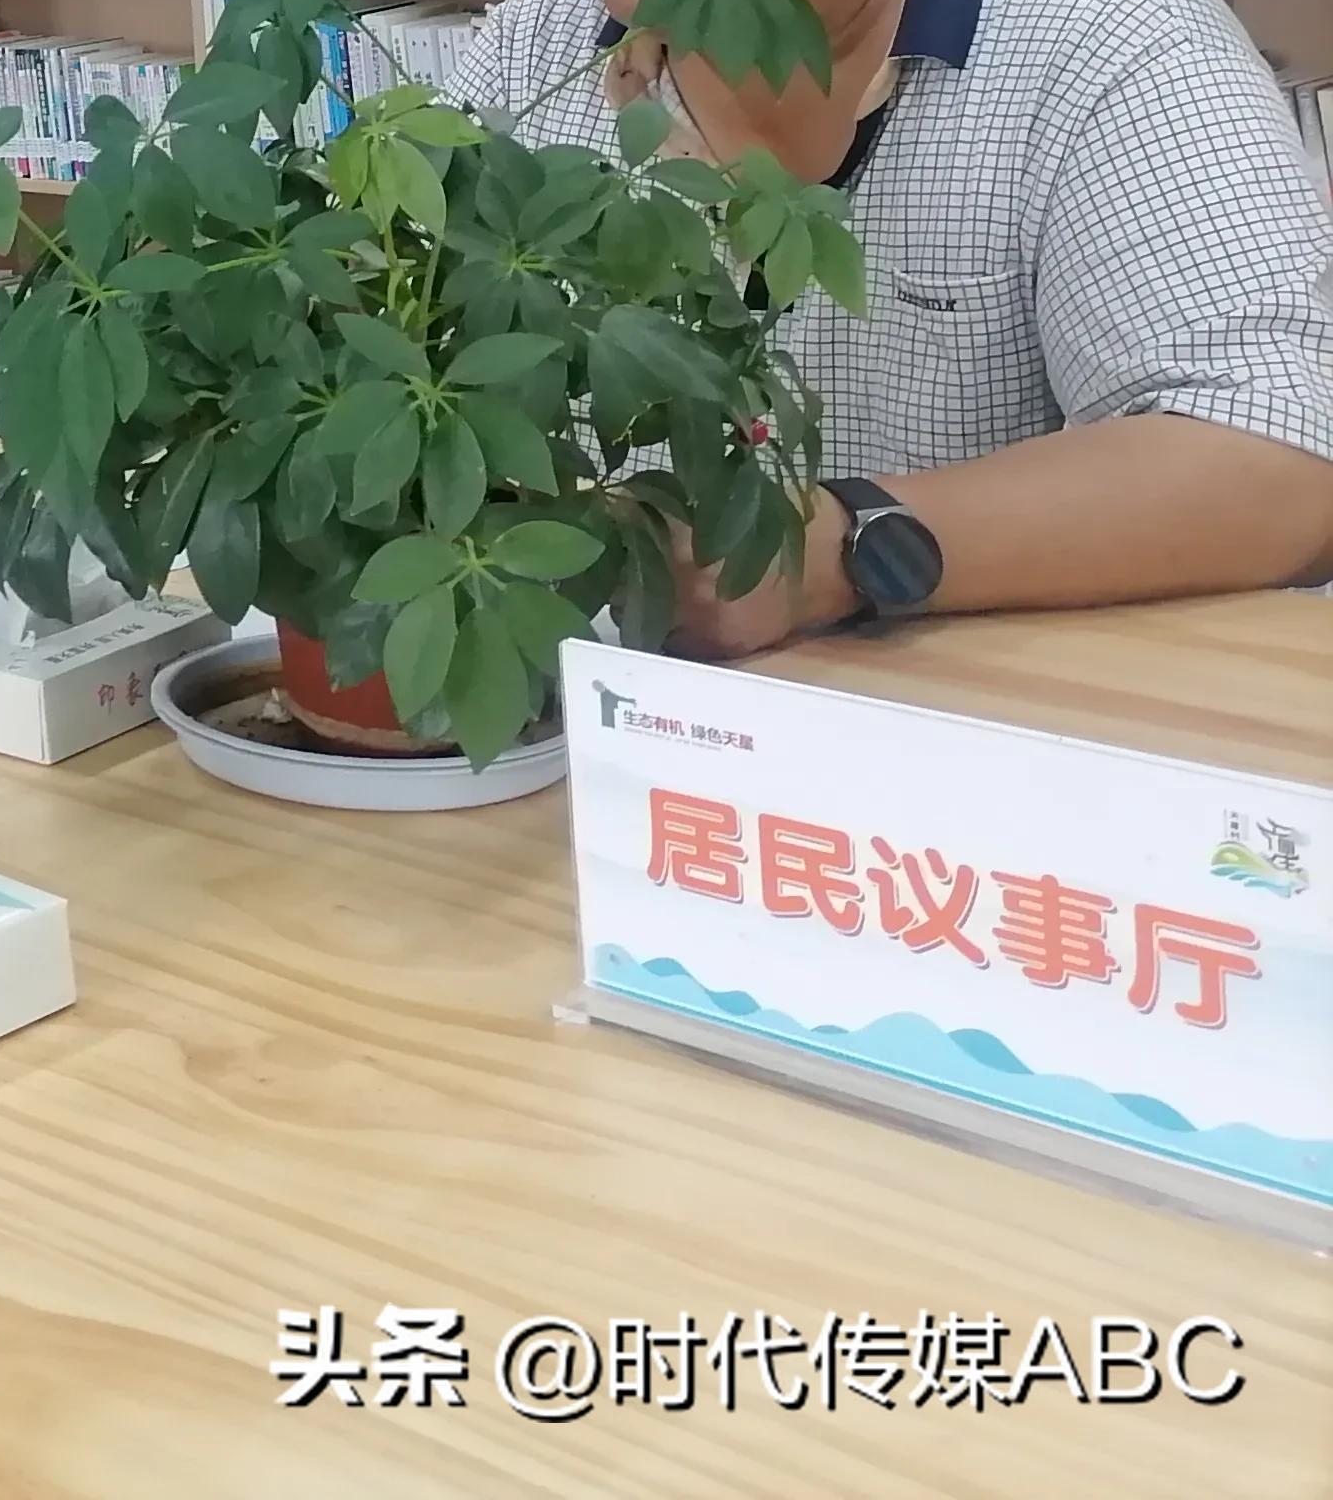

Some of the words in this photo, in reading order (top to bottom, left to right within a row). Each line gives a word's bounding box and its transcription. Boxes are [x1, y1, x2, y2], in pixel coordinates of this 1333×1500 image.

[623, 709, 685, 736] 生态有机
[690, 723, 755, 752] 绿色天星
[646, 786, 1263, 1030] 居民议事厅
